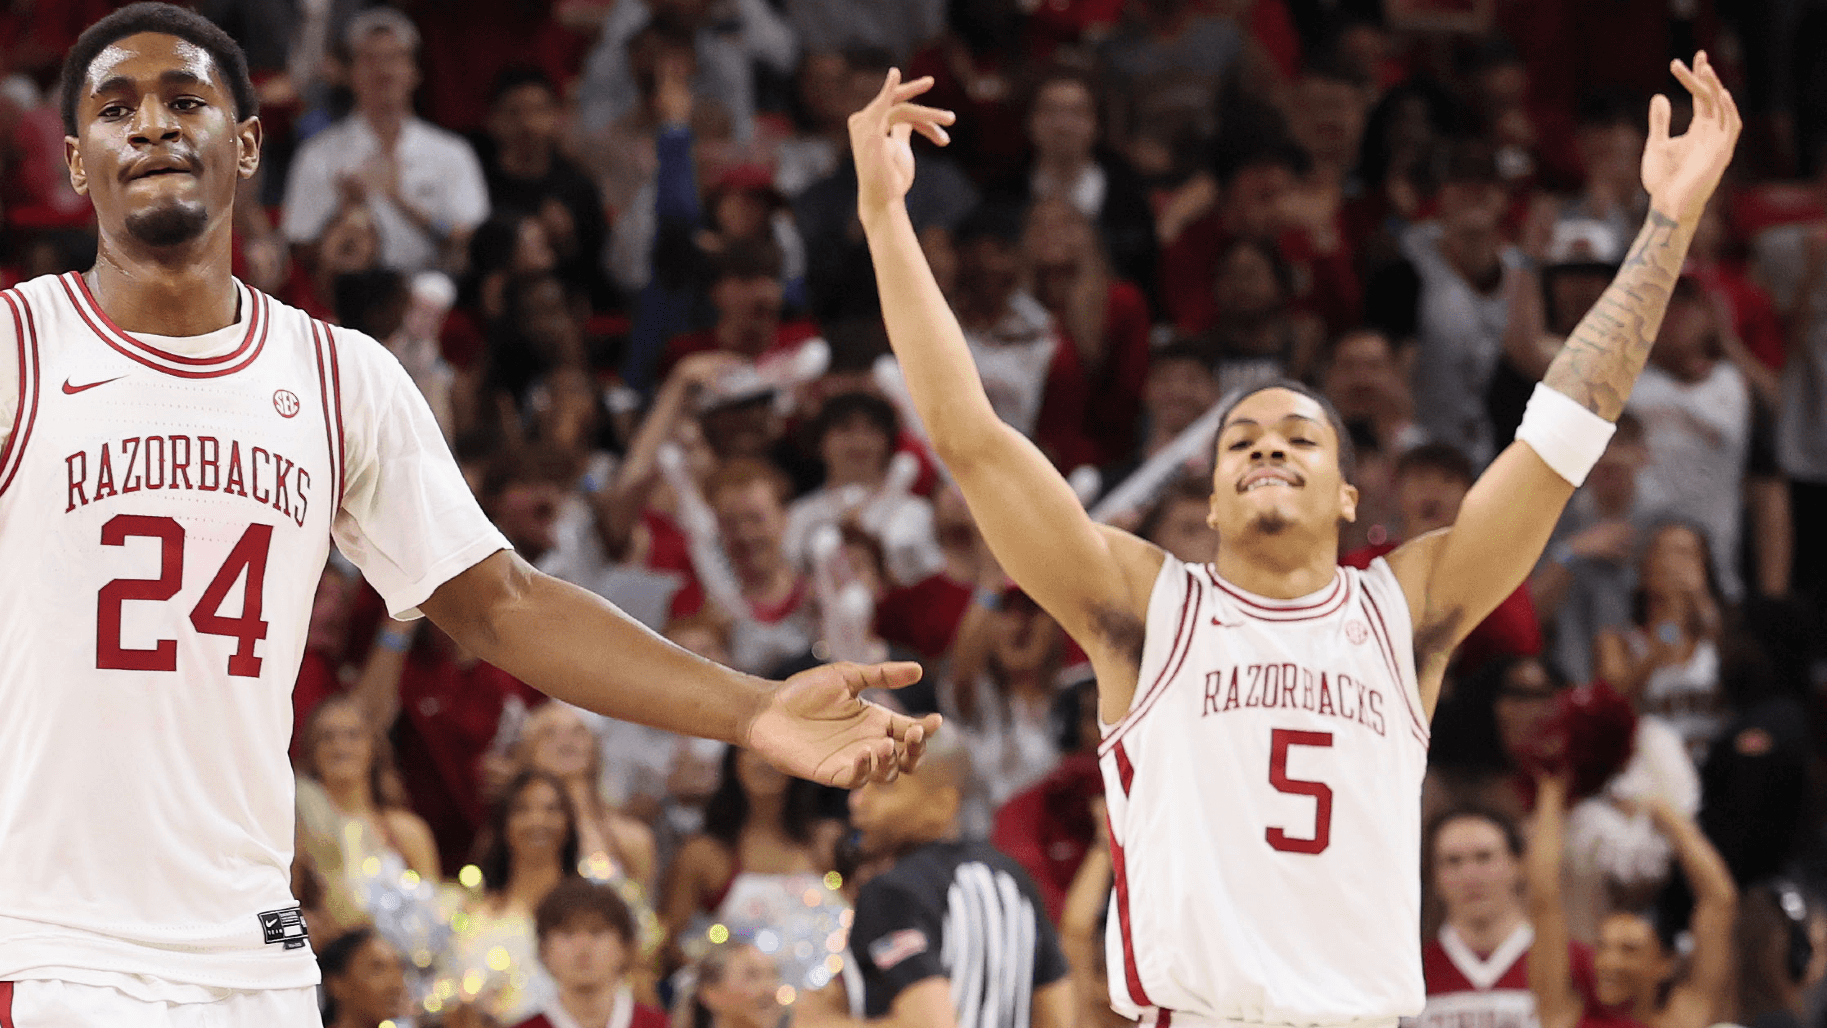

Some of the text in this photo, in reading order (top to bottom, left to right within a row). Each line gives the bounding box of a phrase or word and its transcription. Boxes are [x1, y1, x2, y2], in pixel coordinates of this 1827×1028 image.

[274, 391, 299, 416] SEC
[65, 435, 311, 528] RAZORBACKS
[95, 513, 275, 678] 24
[1202, 663, 1386, 737] RAZORBACKS
[1265, 728, 1333, 854] 5
